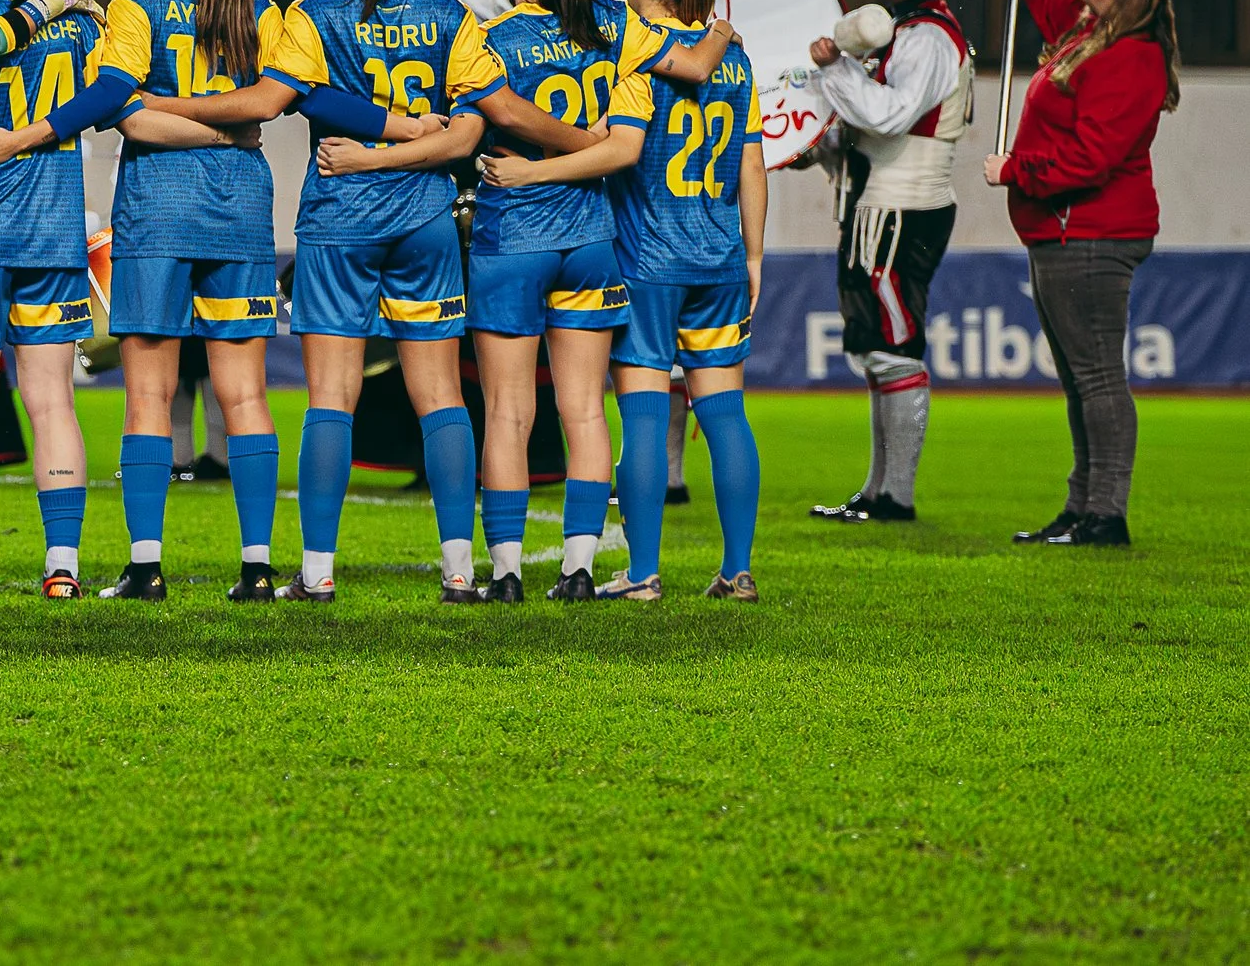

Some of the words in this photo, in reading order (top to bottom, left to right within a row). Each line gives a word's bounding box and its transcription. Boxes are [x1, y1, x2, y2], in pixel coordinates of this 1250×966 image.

[354, 21, 438, 49] REDRU
[665, 98, 735, 199] 22
[48, 585, 74, 598] NIKE
